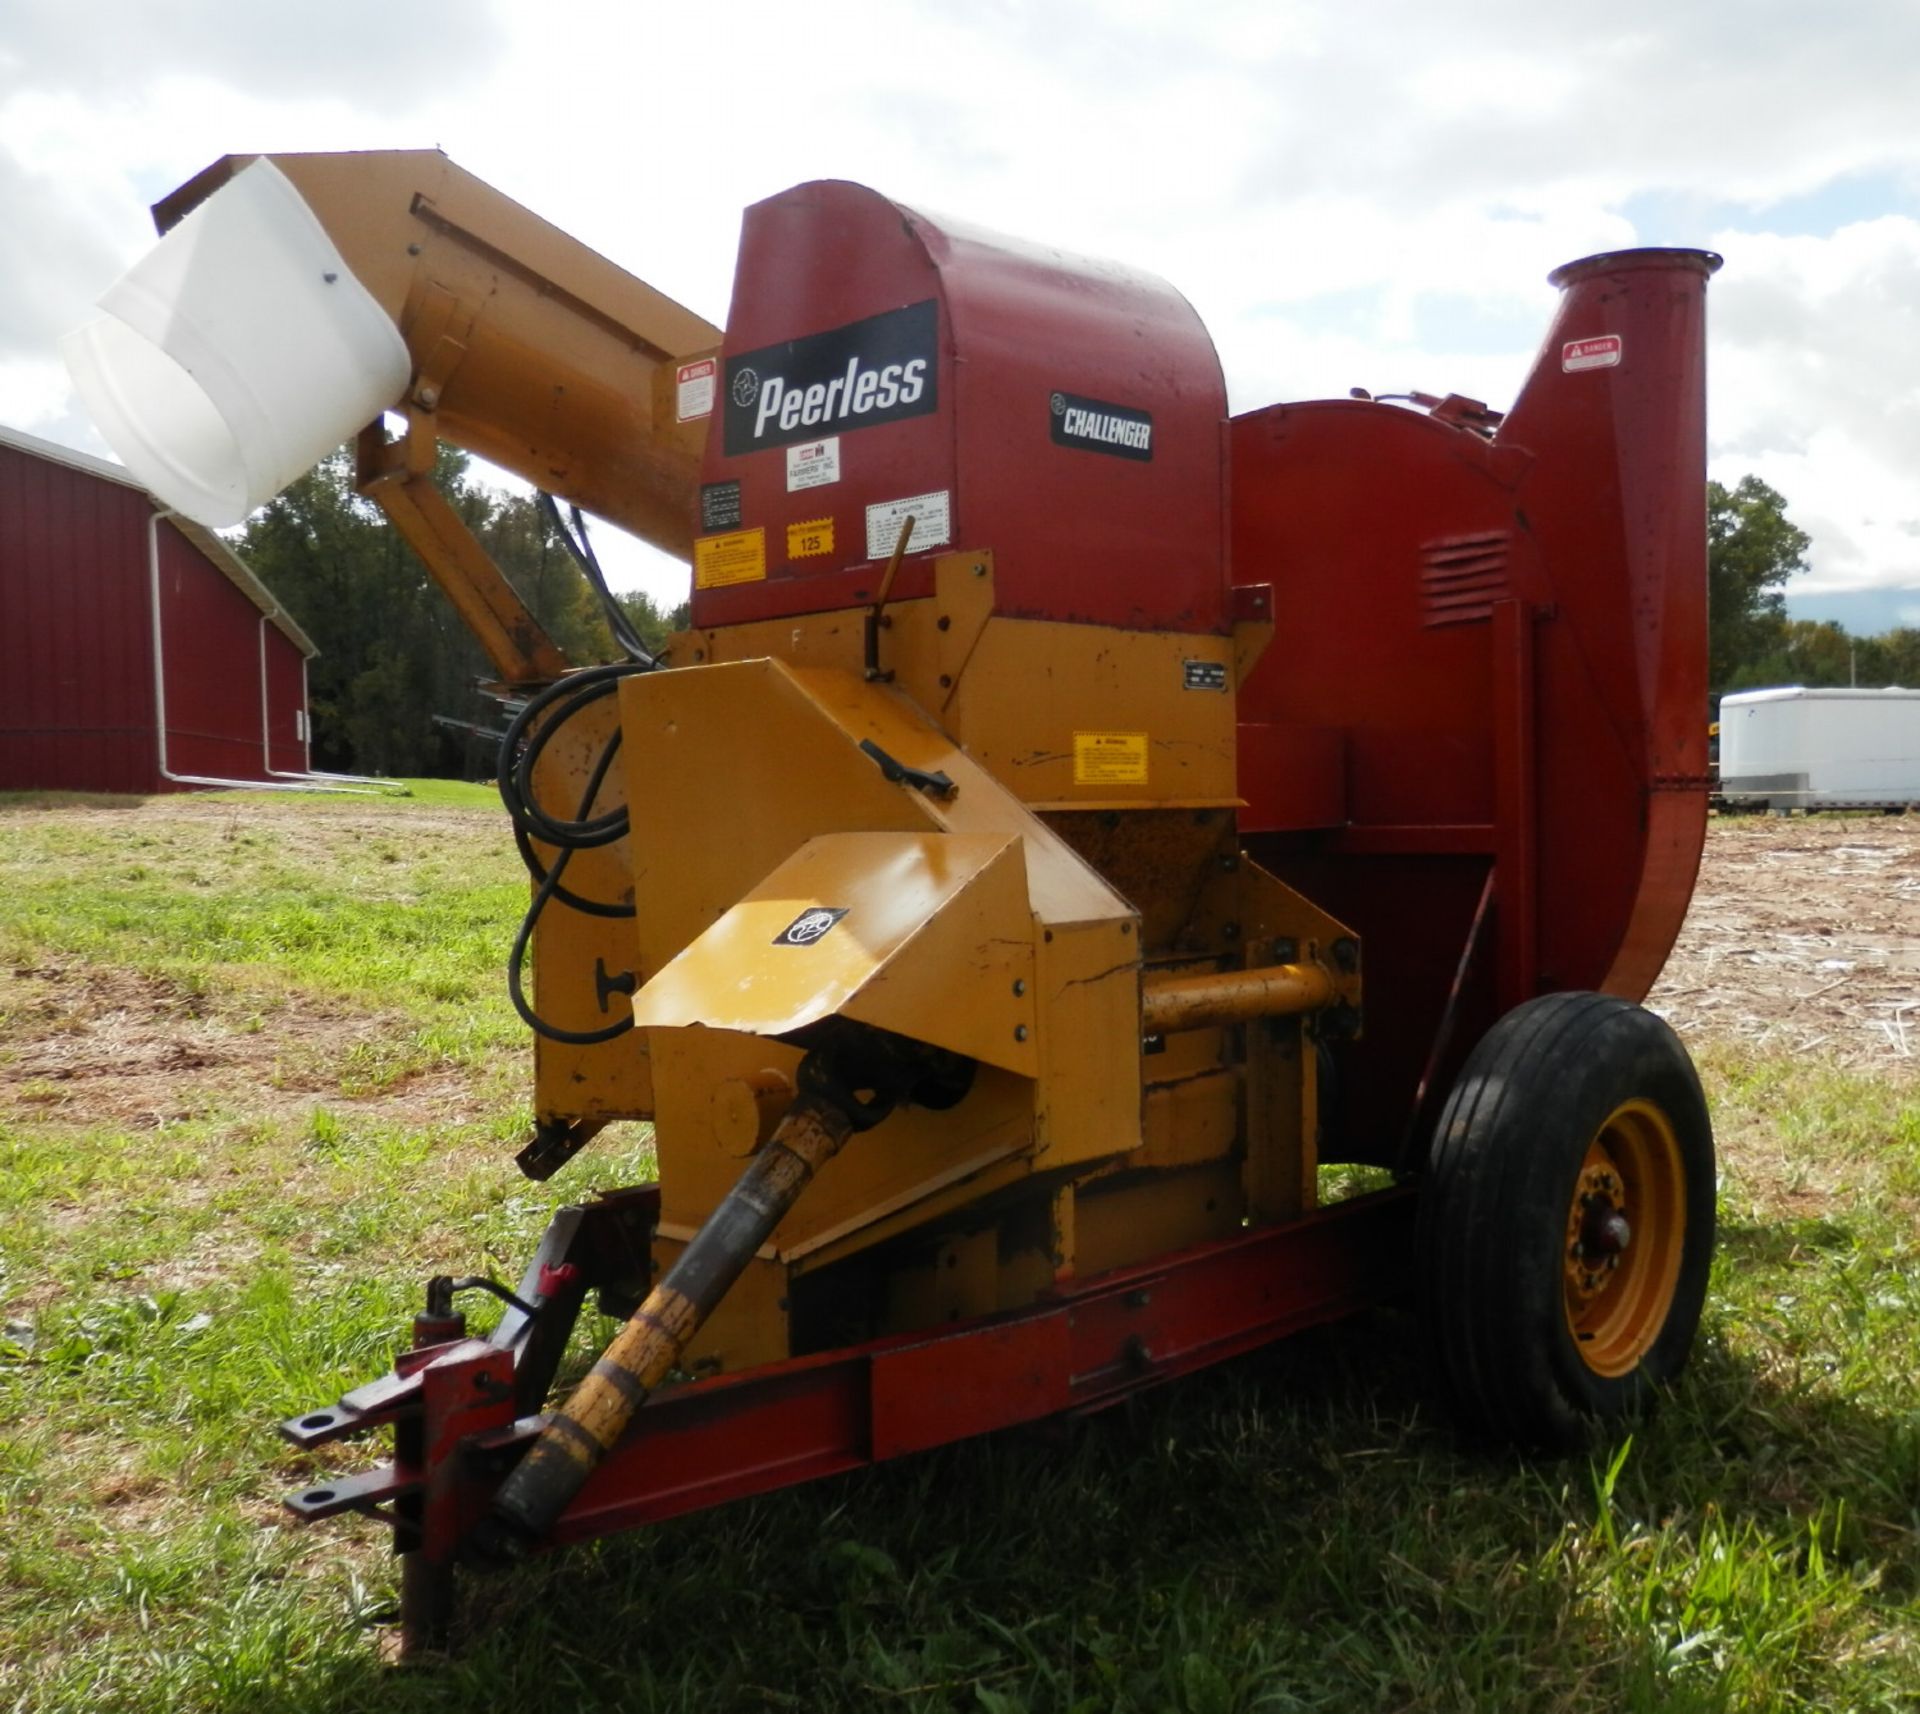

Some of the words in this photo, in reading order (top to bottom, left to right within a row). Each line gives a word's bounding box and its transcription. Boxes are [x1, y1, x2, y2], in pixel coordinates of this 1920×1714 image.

[754, 357, 927, 438] Peerless
[1064, 407, 1151, 450] CHALLENGER
[802, 536, 821, 551] 125
